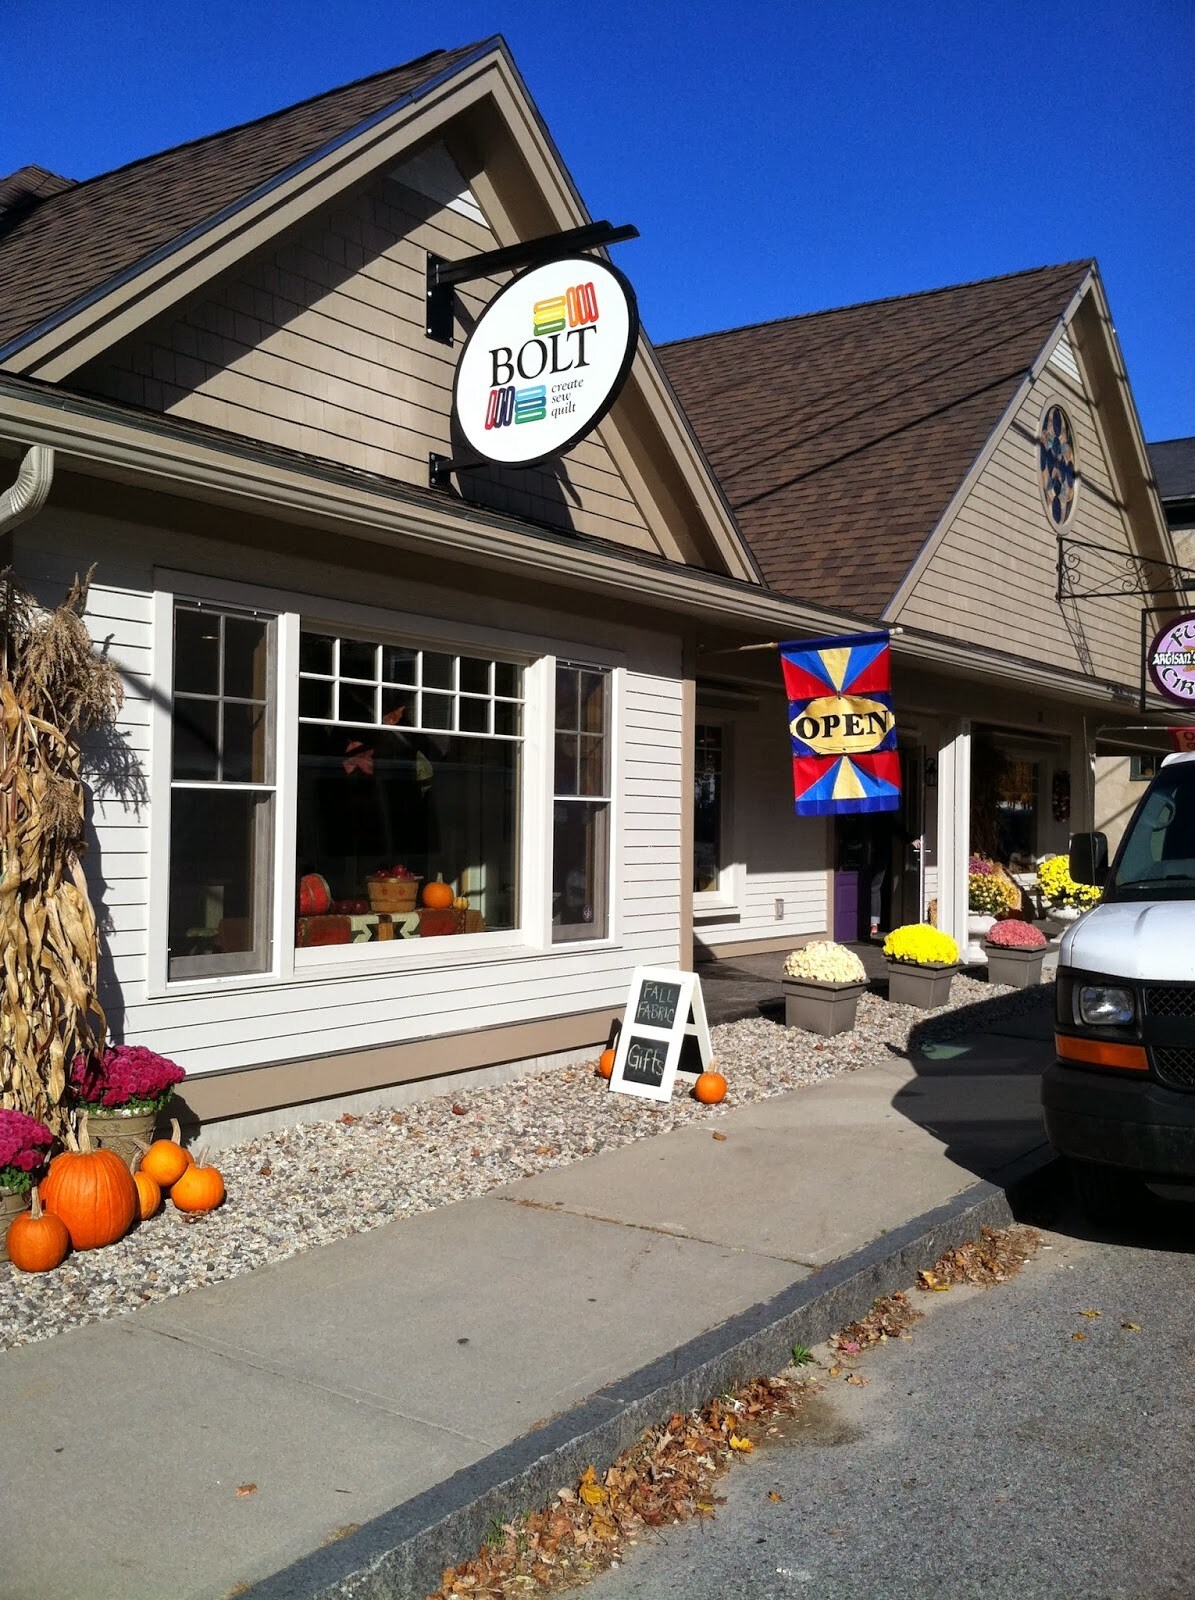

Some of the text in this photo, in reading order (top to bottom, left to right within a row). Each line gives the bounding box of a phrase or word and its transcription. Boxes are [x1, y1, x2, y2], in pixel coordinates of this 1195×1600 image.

[488, 325, 597, 388] BOLT
[551, 379, 584, 393] create
[551, 392, 571, 403] sew
[551, 400, 576, 419] quilt
[795, 710, 889, 740] OPEN
[643, 981, 674, 1003] FALL
[637, 1001, 675, 1024] FABRIC
[627, 1043, 665, 1076] Gifts
